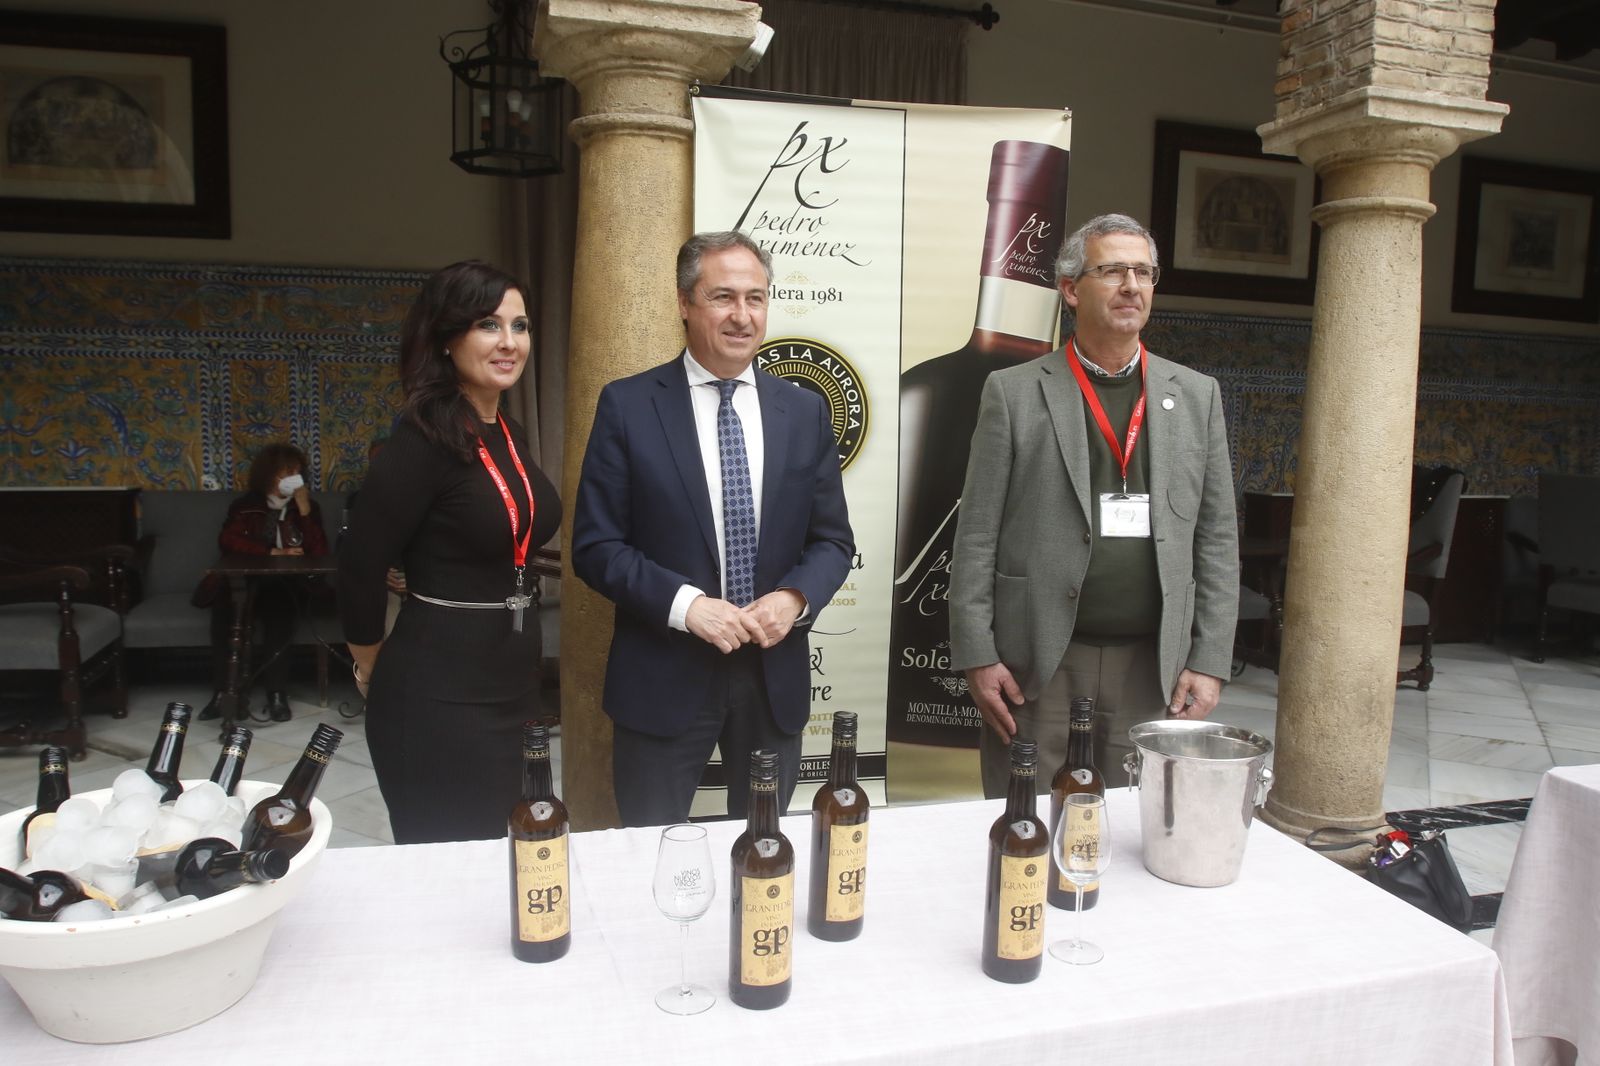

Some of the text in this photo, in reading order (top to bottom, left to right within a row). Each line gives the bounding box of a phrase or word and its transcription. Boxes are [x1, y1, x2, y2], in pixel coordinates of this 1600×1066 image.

[750, 191, 830, 236] pedro
[811, 286, 843, 304] 1981
[757, 346, 861, 430] AS LA AURORA
[964, 718, 973, 727] DE
[838, 866, 867, 895] gp
[527, 884, 563, 914] gp
[745, 903, 771, 913] GRAN
[1009, 902, 1043, 931] gp
[753, 925, 789, 956] gp
